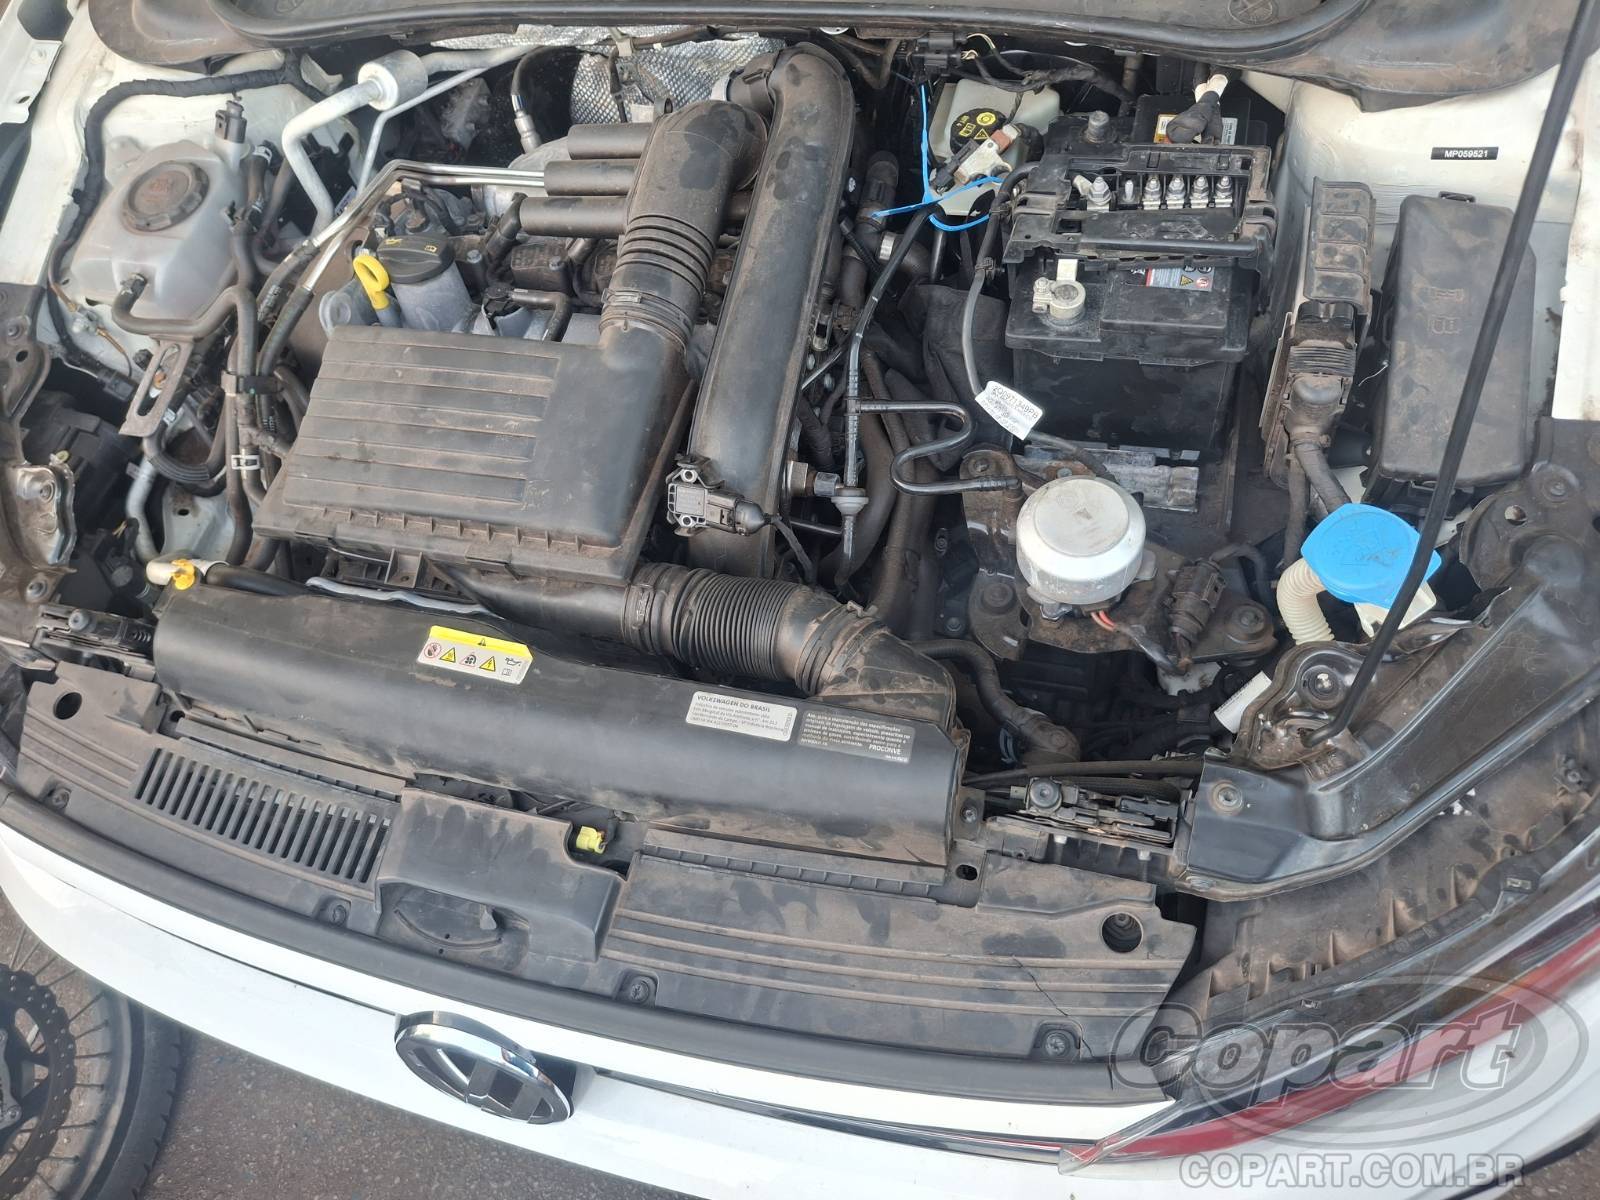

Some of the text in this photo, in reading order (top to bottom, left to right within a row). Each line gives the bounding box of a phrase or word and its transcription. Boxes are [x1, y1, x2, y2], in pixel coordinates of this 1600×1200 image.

[1444, 150, 1488, 158] MP059521
[697, 695, 739, 707] VOLKSWAGEN
[750, 704, 770, 713] BRASIL
[869, 743, 902, 755] PROCONVE
